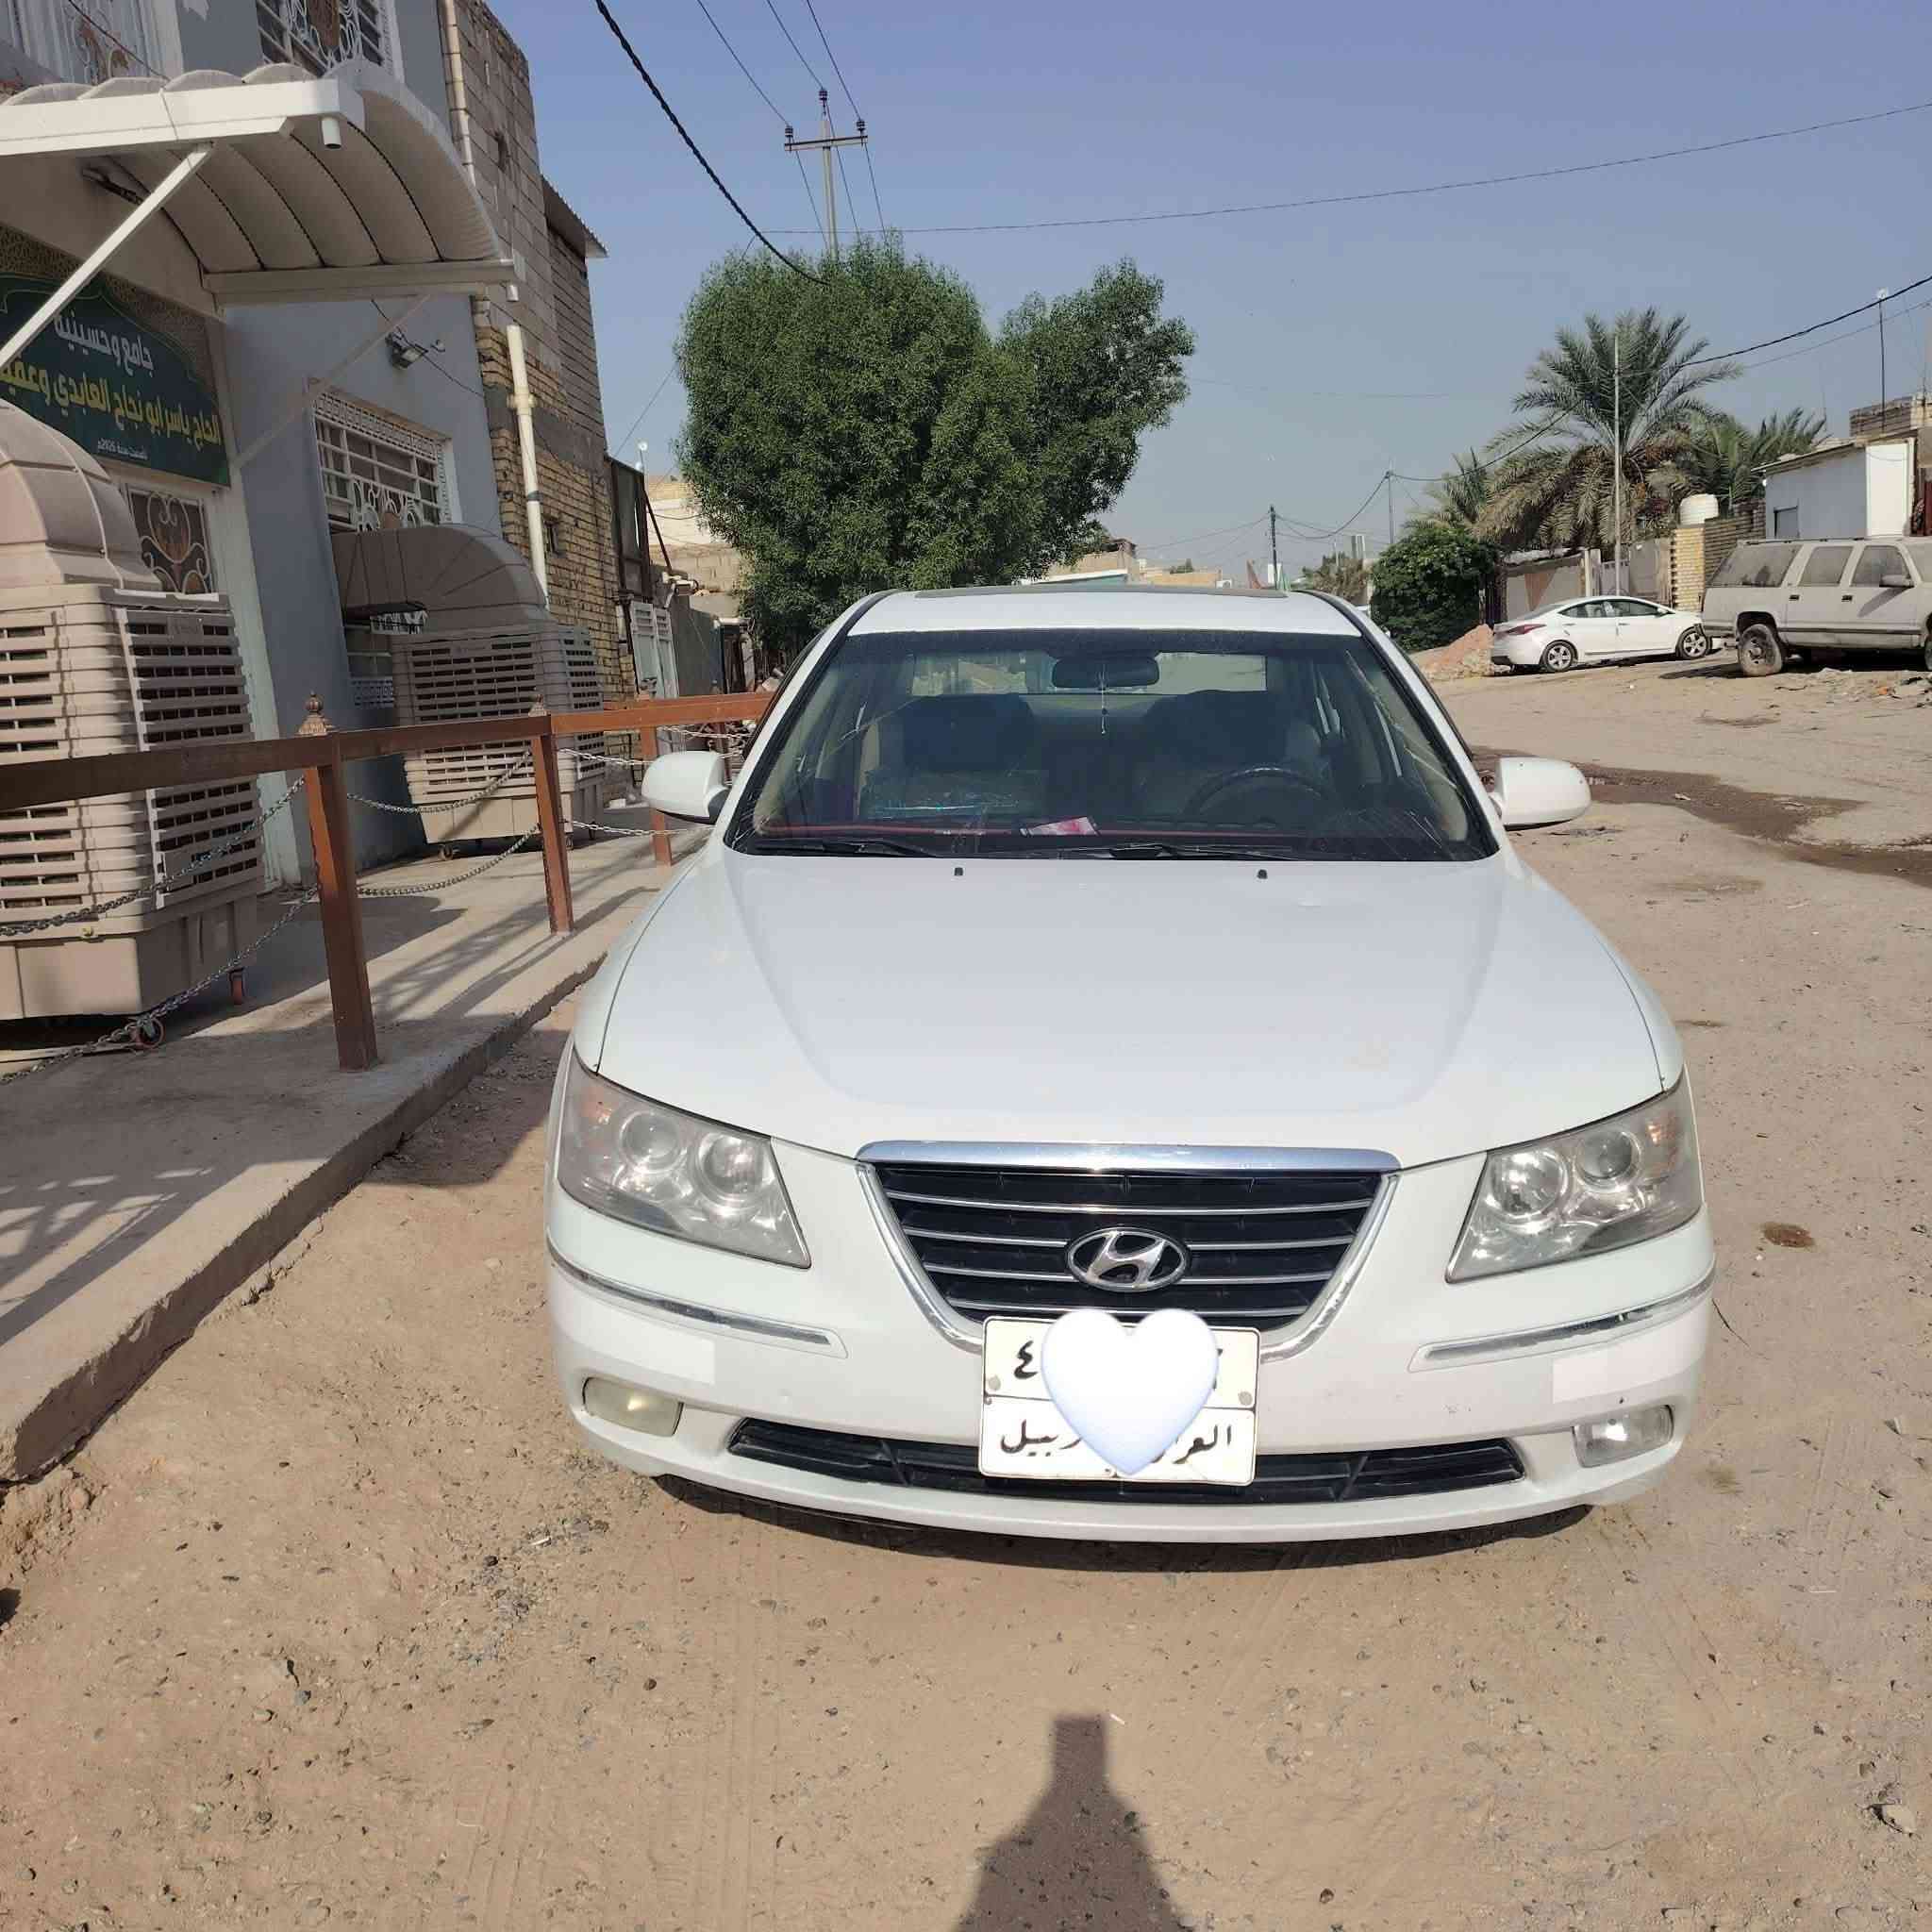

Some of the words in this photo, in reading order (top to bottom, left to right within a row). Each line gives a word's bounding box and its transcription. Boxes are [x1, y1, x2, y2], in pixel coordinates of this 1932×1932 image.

[121, 334, 154, 378] جامع
[53, 372, 110, 417] العابدي
[165, 402, 193, 444] ياسر
[193, 409, 222, 452] الحاج
[1000, 1419, 1083, 1457] ربيل
[1152, 1424, 1232, 1465] العر
